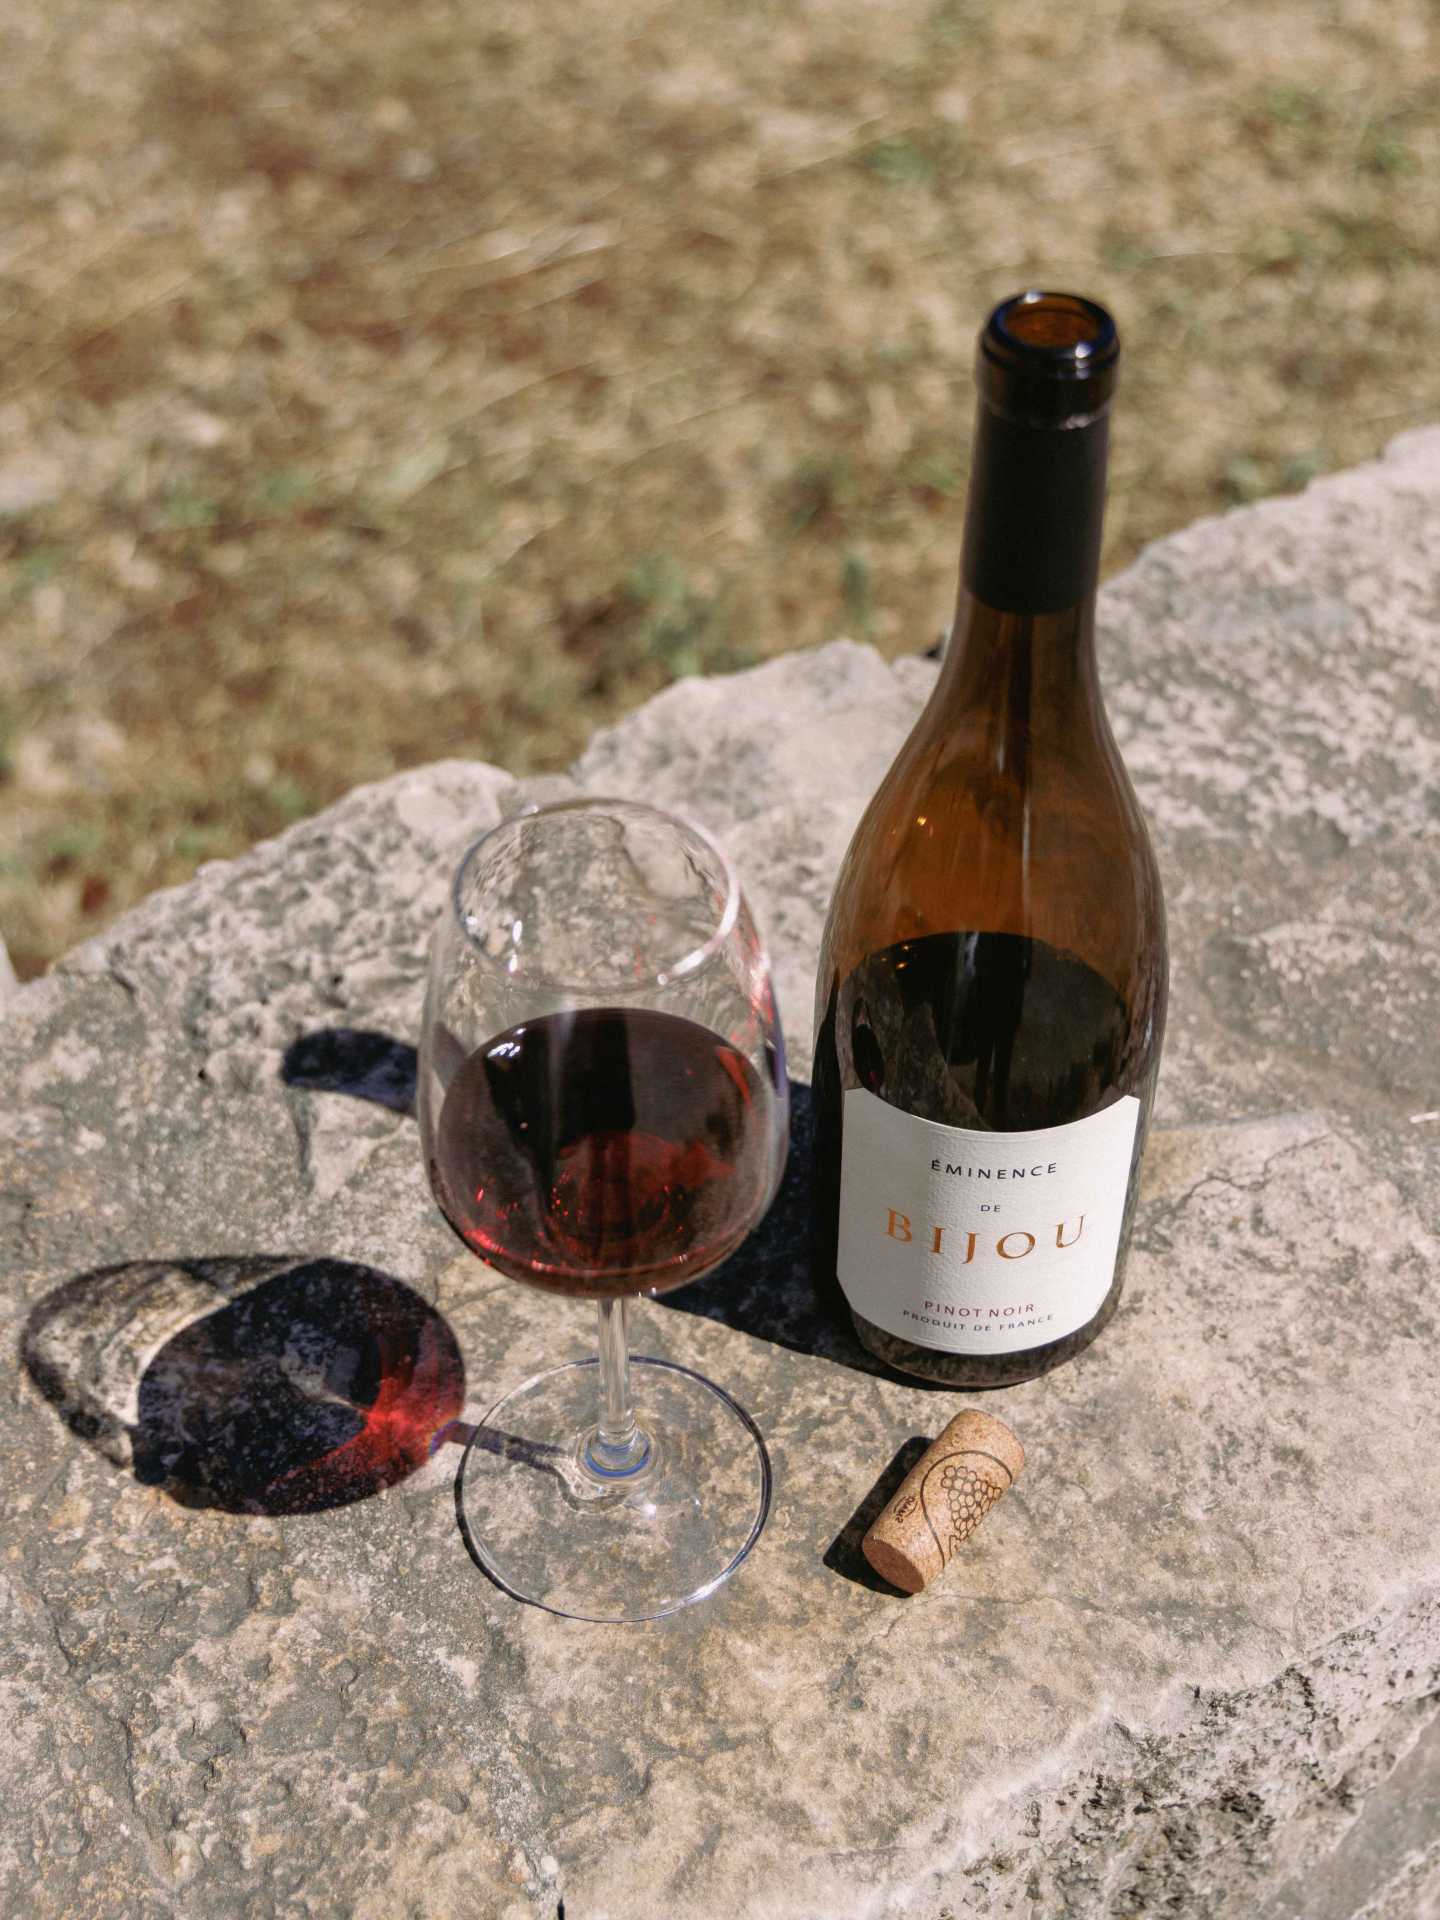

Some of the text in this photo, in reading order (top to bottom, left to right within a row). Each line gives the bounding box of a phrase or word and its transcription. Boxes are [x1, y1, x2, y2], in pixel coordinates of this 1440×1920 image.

[930, 1158, 1057, 1180] ÉMINENCE
[980, 1204, 1001, 1213] DE
[884, 1208, 1087, 1264] BIJOU
[924, 1300, 1035, 1318] PINOT NOIR
[902, 1310, 966, 1330] PRODUIT
[1000, 1314, 1054, 1330] FRANCE
